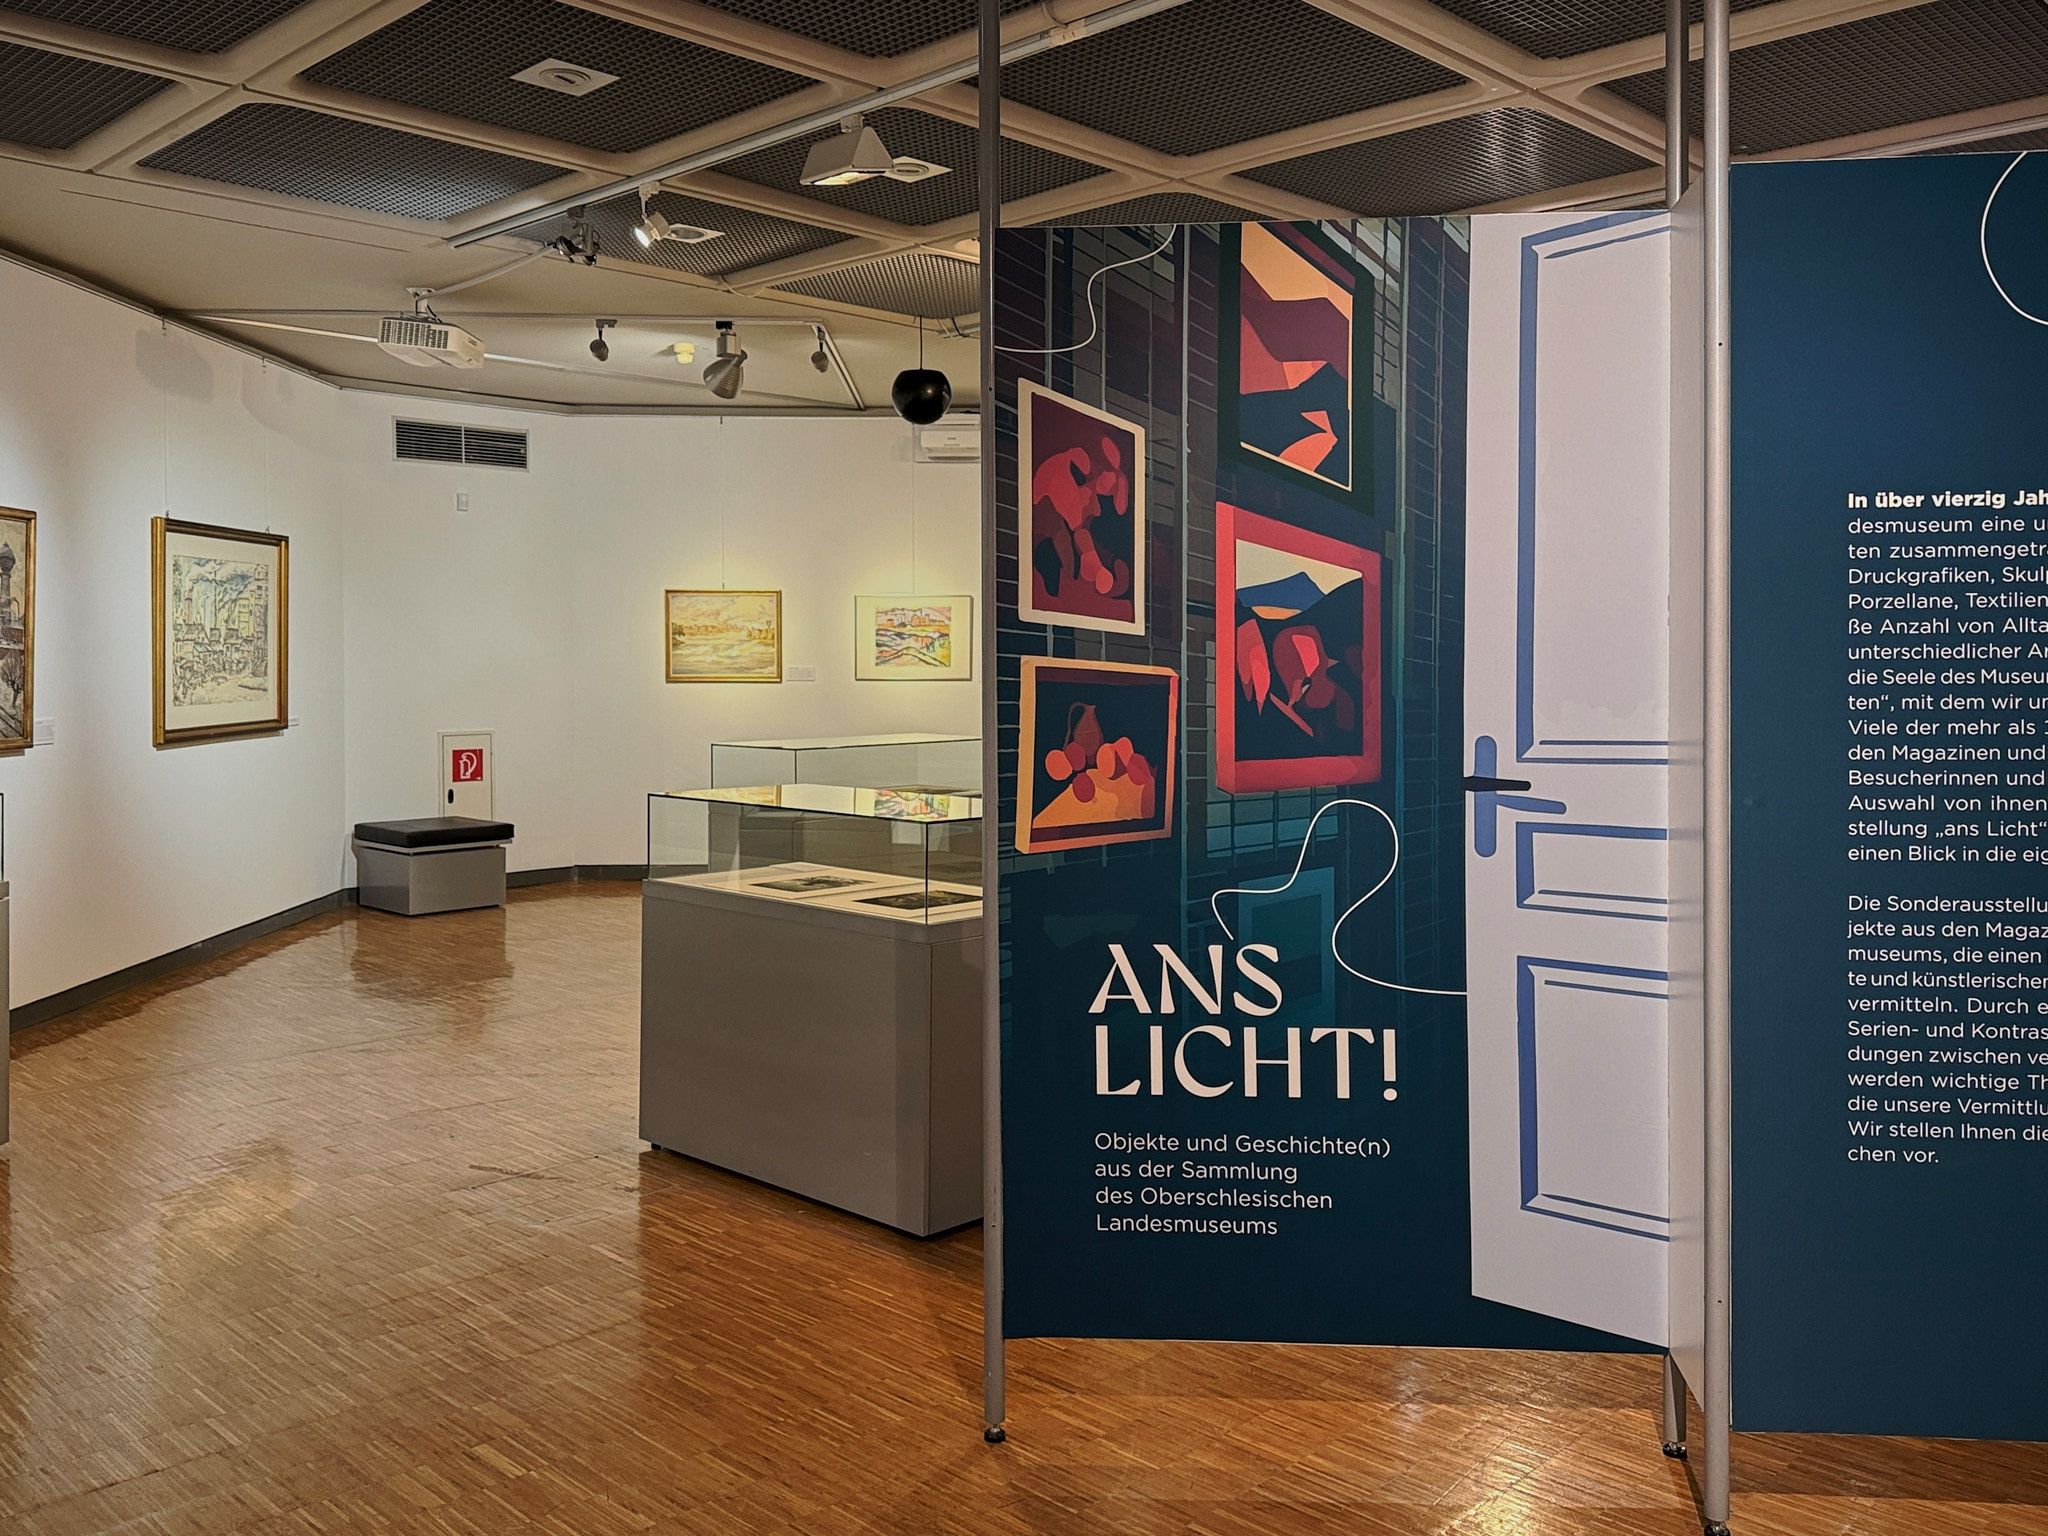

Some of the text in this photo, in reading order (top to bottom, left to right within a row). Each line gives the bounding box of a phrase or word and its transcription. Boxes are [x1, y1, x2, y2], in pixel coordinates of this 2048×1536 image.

[1848, 492, 1868, 509] In
[1875, 491, 1925, 509] über
[1931, 489, 2006, 510] vierzig
[1847, 515, 2048, 534] desmuseum eine u
[1847, 541, 2048, 560] ten zusammengetr
[1848, 565, 2048, 587] Druckgrafiken, Skul
[1848, 591, 2048, 611] Porzellane, Textilien
[1848, 618, 1873, 635] ße
[1879, 617, 1949, 635] Anzahl
[1957, 621, 1994, 634] von
[1848, 642, 2022, 660] unterschiedlicher
[1847, 668, 2048, 685] die Seele des Museu
[1847, 694, 1895, 712] ten“,
[1901, 693, 1934, 710] mit
[1939, 693, 1985, 710] dem
[1991, 693, 2023, 710] wir
[1848, 718, 1899, 736] Viele
[1905, 718, 1941, 736] der
[1947, 718, 2001, 736] mehr
[2007, 718, 2036, 735] als
[1847, 744, 2046, 764] den Magazinen und
[1848, 769, 2045, 786] Besucherinnen und
[1848, 794, 2047, 812] Auswahl von ihnen
[1848, 819, 2048, 839] stellung „ans Licht“
[1847, 844, 1902, 861] einen
[1908, 845, 1957, 862] Blick
[1962, 845, 1980, 862] in
[1985, 845, 2017, 862] die
[1848, 894, 2048, 913] Die Sonderausstellu
[1846, 919, 1896, 939] jekte
[1901, 924, 1936, 937] aus
[1941, 921, 1979, 938] den
[1848, 946, 2042, 965] museums, die einen
[1088, 943, 1283, 1017] ANS
[1847, 970, 1867, 986] te
[1871, 970, 1908, 987] und
[1847, 996, 1958, 1013] vermitteln.
[1967, 997, 2029, 1014] Durch
[1848, 1020, 1919, 1037] Serien-
[1926, 1022, 1964, 1038] und
[1095, 1025, 1398, 1101] LICHT!
[1847, 1045, 1923, 1065] dungen
[1928, 1047, 2021, 1065] zwischen
[1847, 1070, 1923, 1088] werden
[1931, 1072, 2020, 1093] wichtige
[1847, 1095, 1878, 1112] die
[1884, 1099, 1951, 1114] unsere
[1847, 1120, 1884, 1137] Wir
[1889, 1121, 1954, 1139] stellen
[1961, 1122, 2016, 1140] Ihnen
[1094, 1132, 1391, 1159] Objekte und Geschichte(n)
[1847, 1145, 1939, 1163] chen vor.
[1094, 1159, 1298, 1184] aus der Sammlung
[1095, 1186, 1333, 1209] des Oberschlesischen
[1096, 1213, 1278, 1235] Landesmuseums
